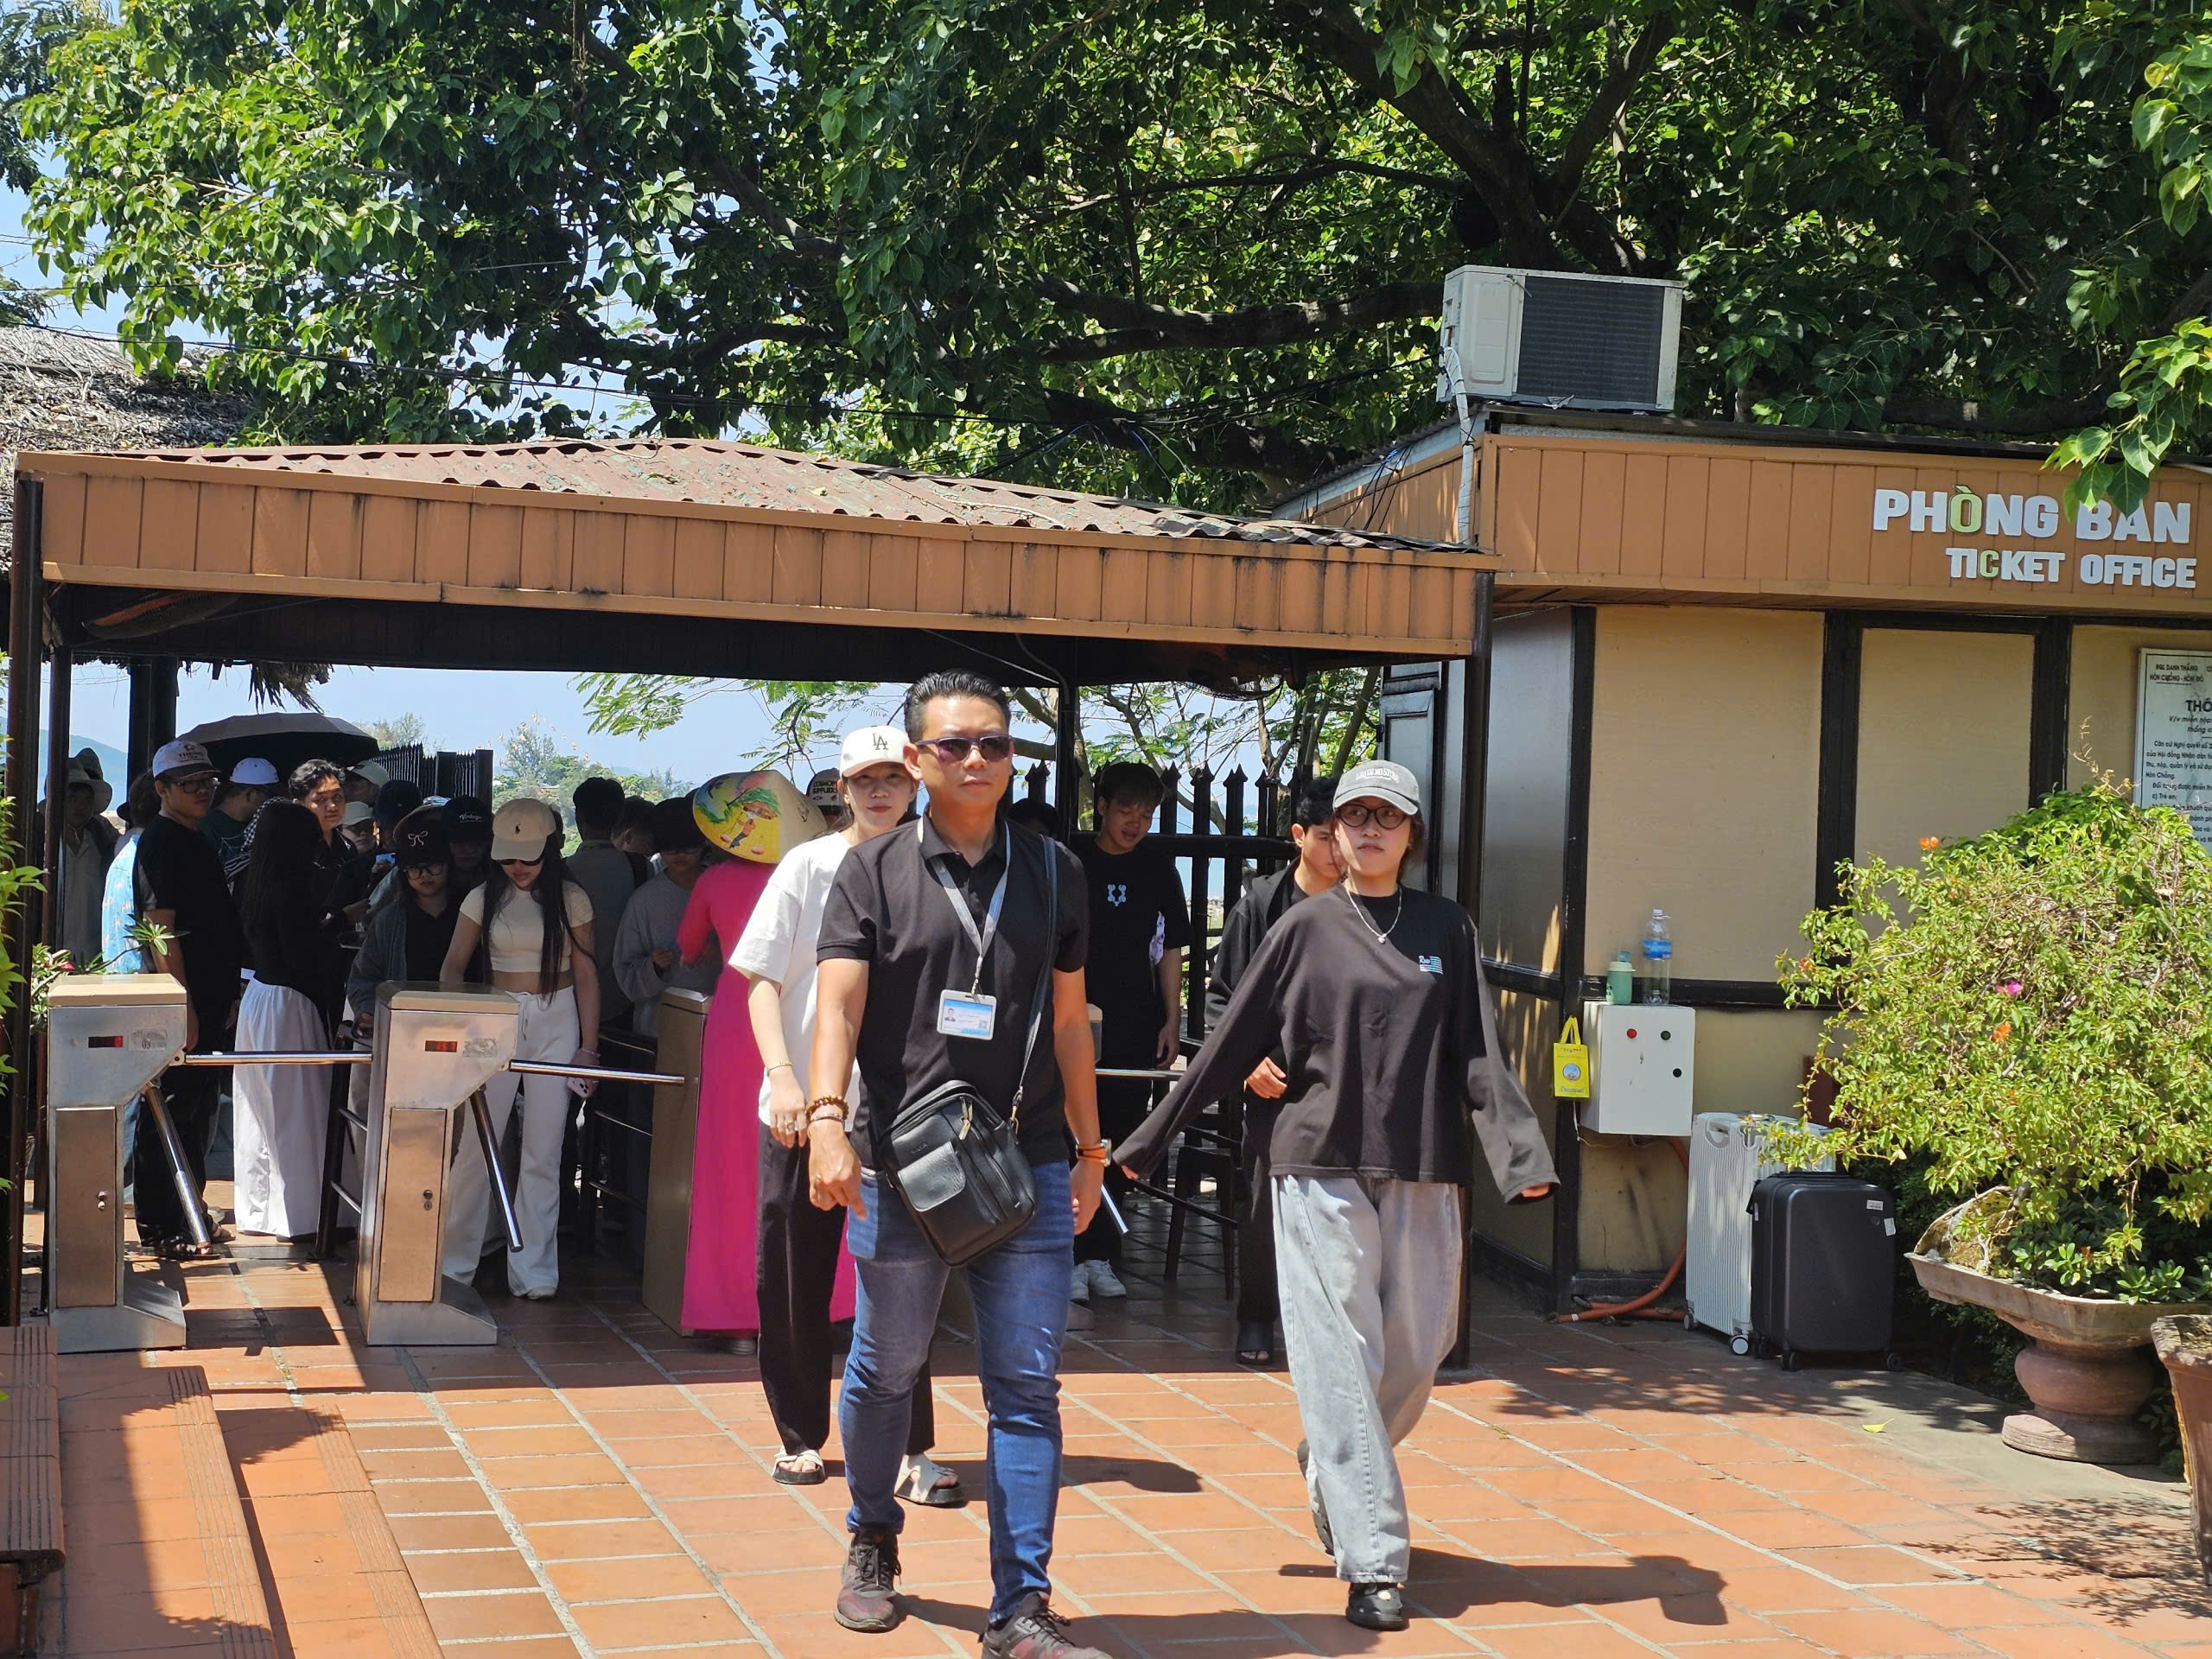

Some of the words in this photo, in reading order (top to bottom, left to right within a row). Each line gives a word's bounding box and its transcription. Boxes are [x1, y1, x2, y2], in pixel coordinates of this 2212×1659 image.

[1873, 485, 2059, 538] PHÒNG
[1945, 548, 2065, 582] TICKET
[2081, 554, 2196, 588] OFFICE
[873, 733, 888, 751] LA
